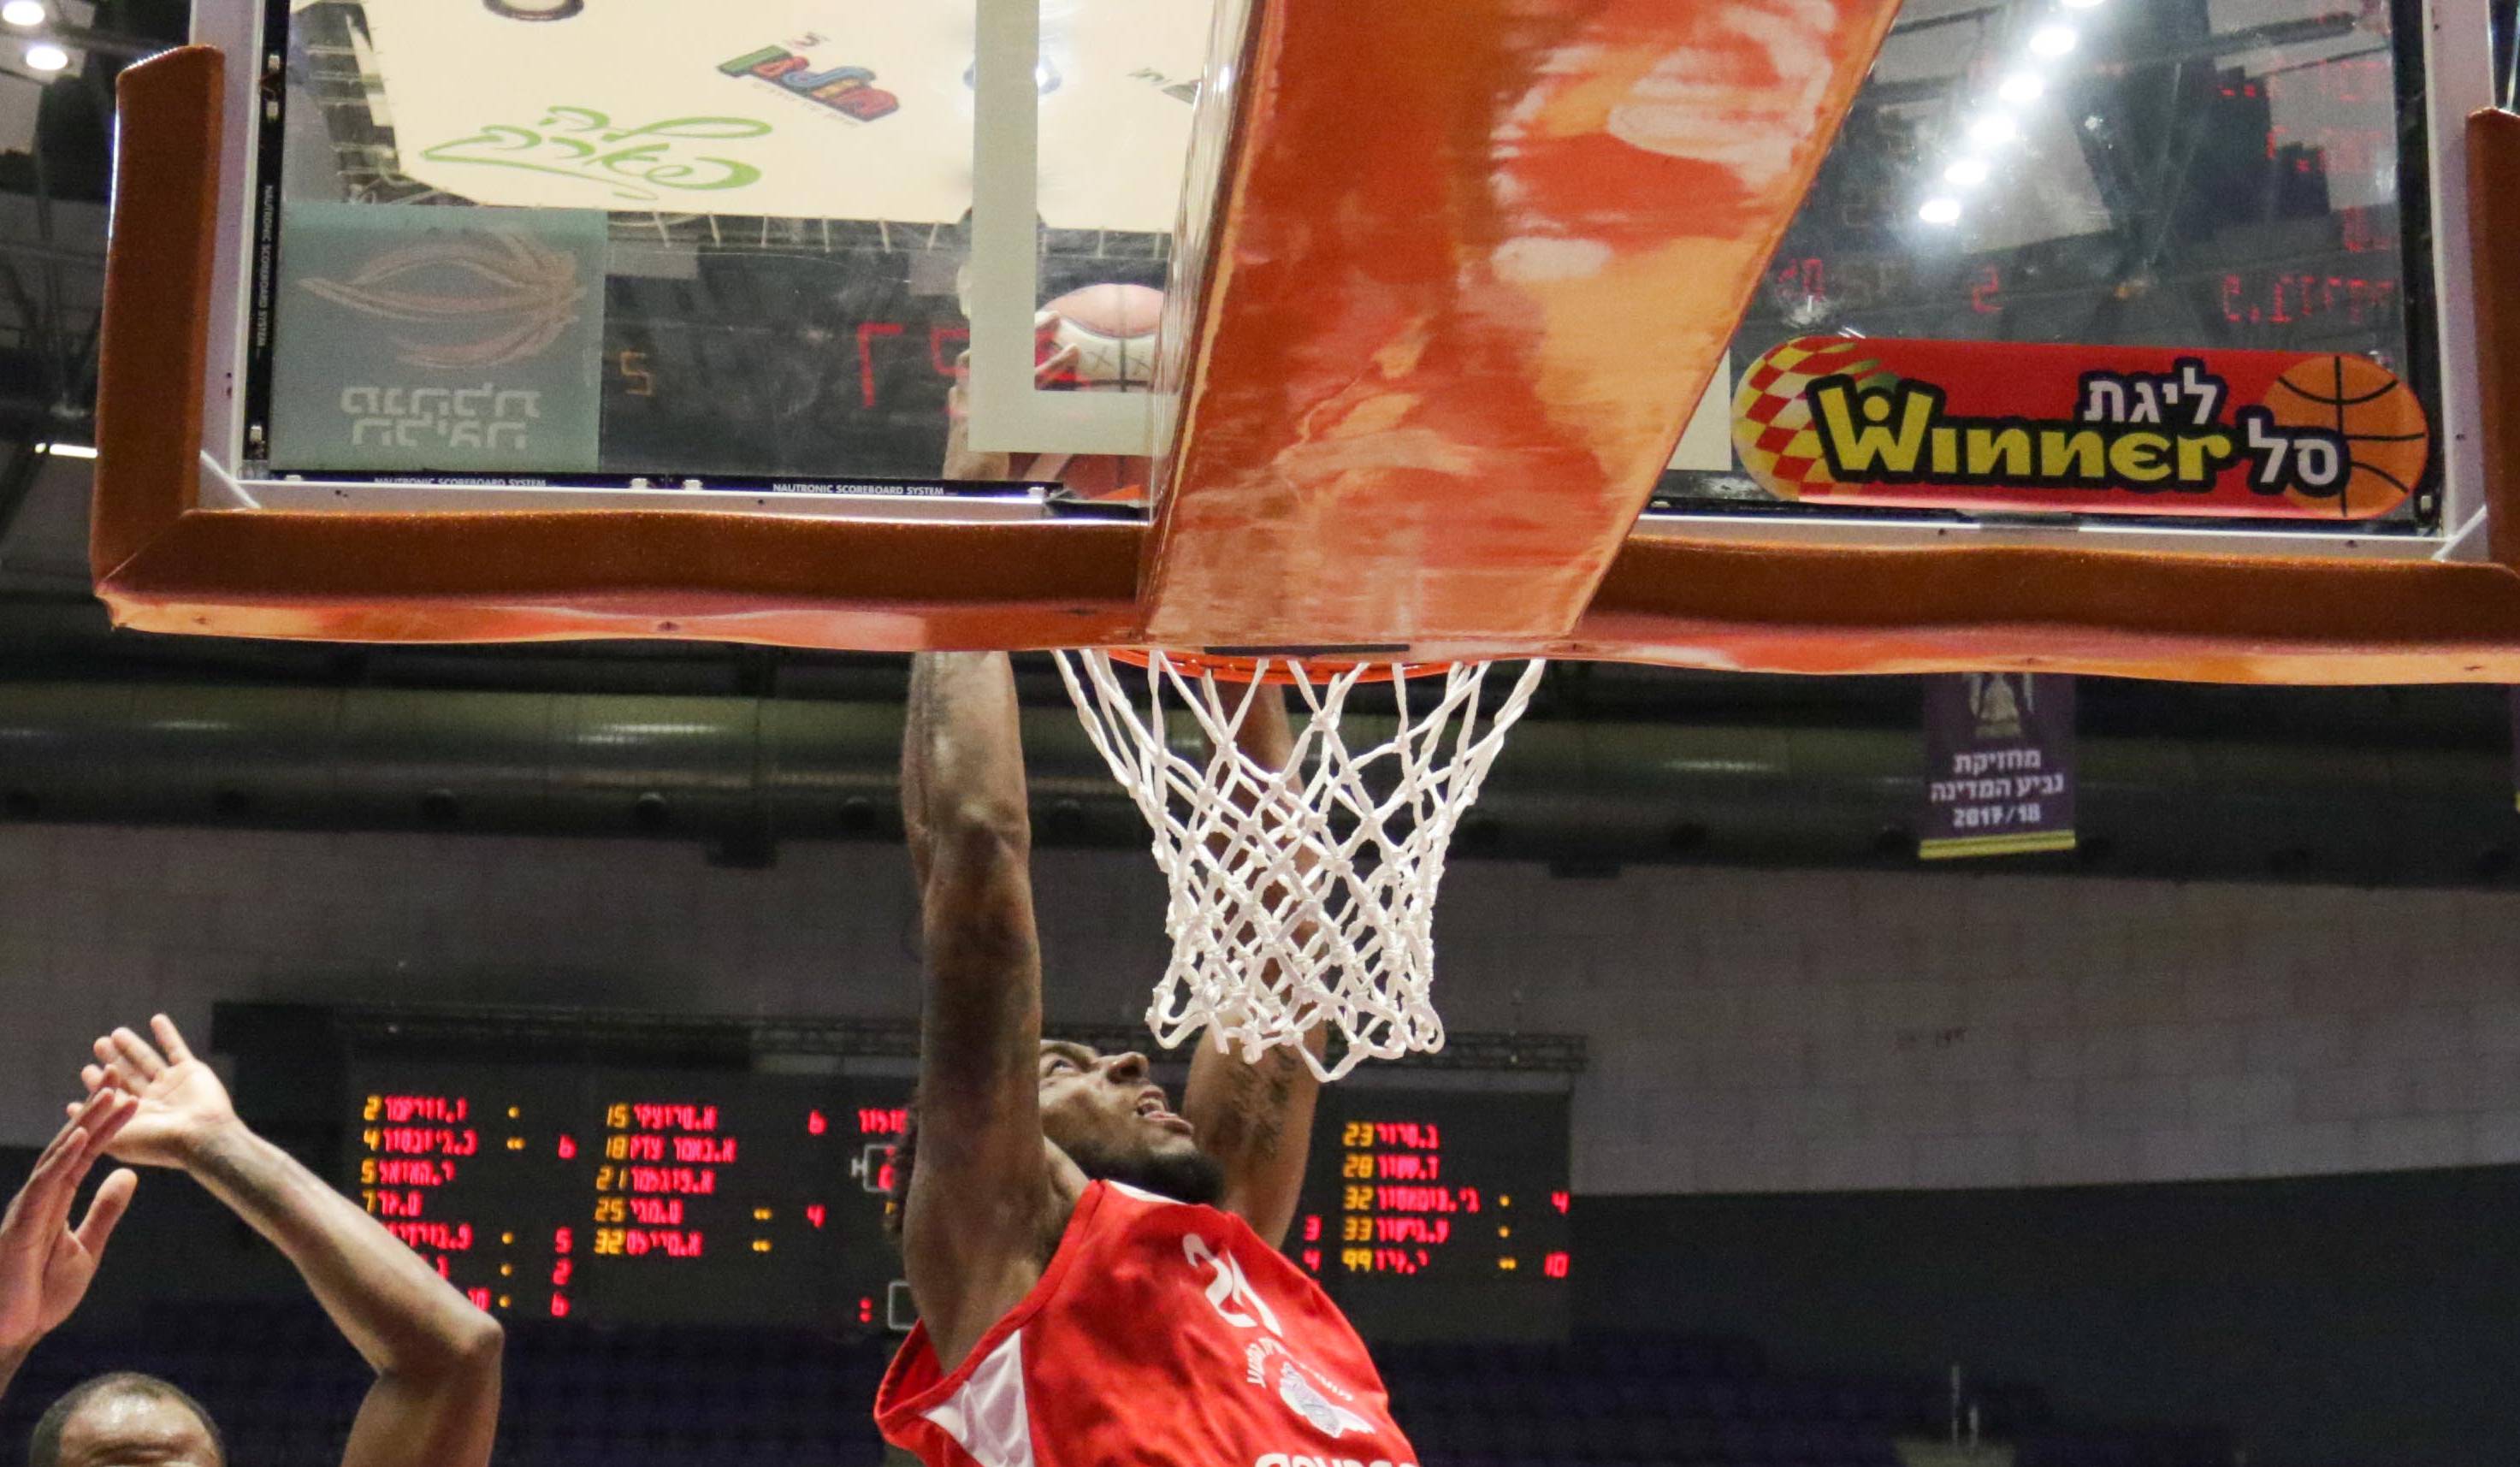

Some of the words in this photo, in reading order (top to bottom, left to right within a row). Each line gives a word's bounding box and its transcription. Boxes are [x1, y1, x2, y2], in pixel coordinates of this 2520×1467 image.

[2082, 365, 2222, 424] ליגת
[2247, 417, 2340, 485] סל
[772, 483, 833, 493] NAUTRONIC
[836, 484, 903, 494] SCOREBOARD
[907, 486, 944, 495] SYSTEM
[1953, 749, 2041, 776] מחזיקת
[1930, 778, 2011, 802] המדינה
[1953, 802, 2041, 827] 2017/18
[364, 1096, 382, 1121] 2
[607, 1104, 629, 1128] 15
[364, 1129, 380, 1150] 4
[1343, 1122, 1374, 1146] 23
[606, 1135, 628, 1159] 18
[361, 1158, 376, 1184] 5
[1343, 1154, 1374, 1178] 28
[596, 1166, 628, 1191] 21
[595, 1198, 625, 1222] 25
[1345, 1186, 1374, 1210] 32
[1552, 1193, 1569, 1213] 4
[807, 1206, 825, 1227] 4
[1304, 1216, 1321, 1240] 3
[1344, 1216, 1373, 1240] 33
[555, 1227, 571, 1253] 5
[595, 1228, 624, 1254] 32
[553, 1259, 571, 1285] 2
[1304, 1248, 1322, 1272] 4
[1342, 1249, 1372, 1271] 99
[1545, 1252, 1569, 1277] 10
